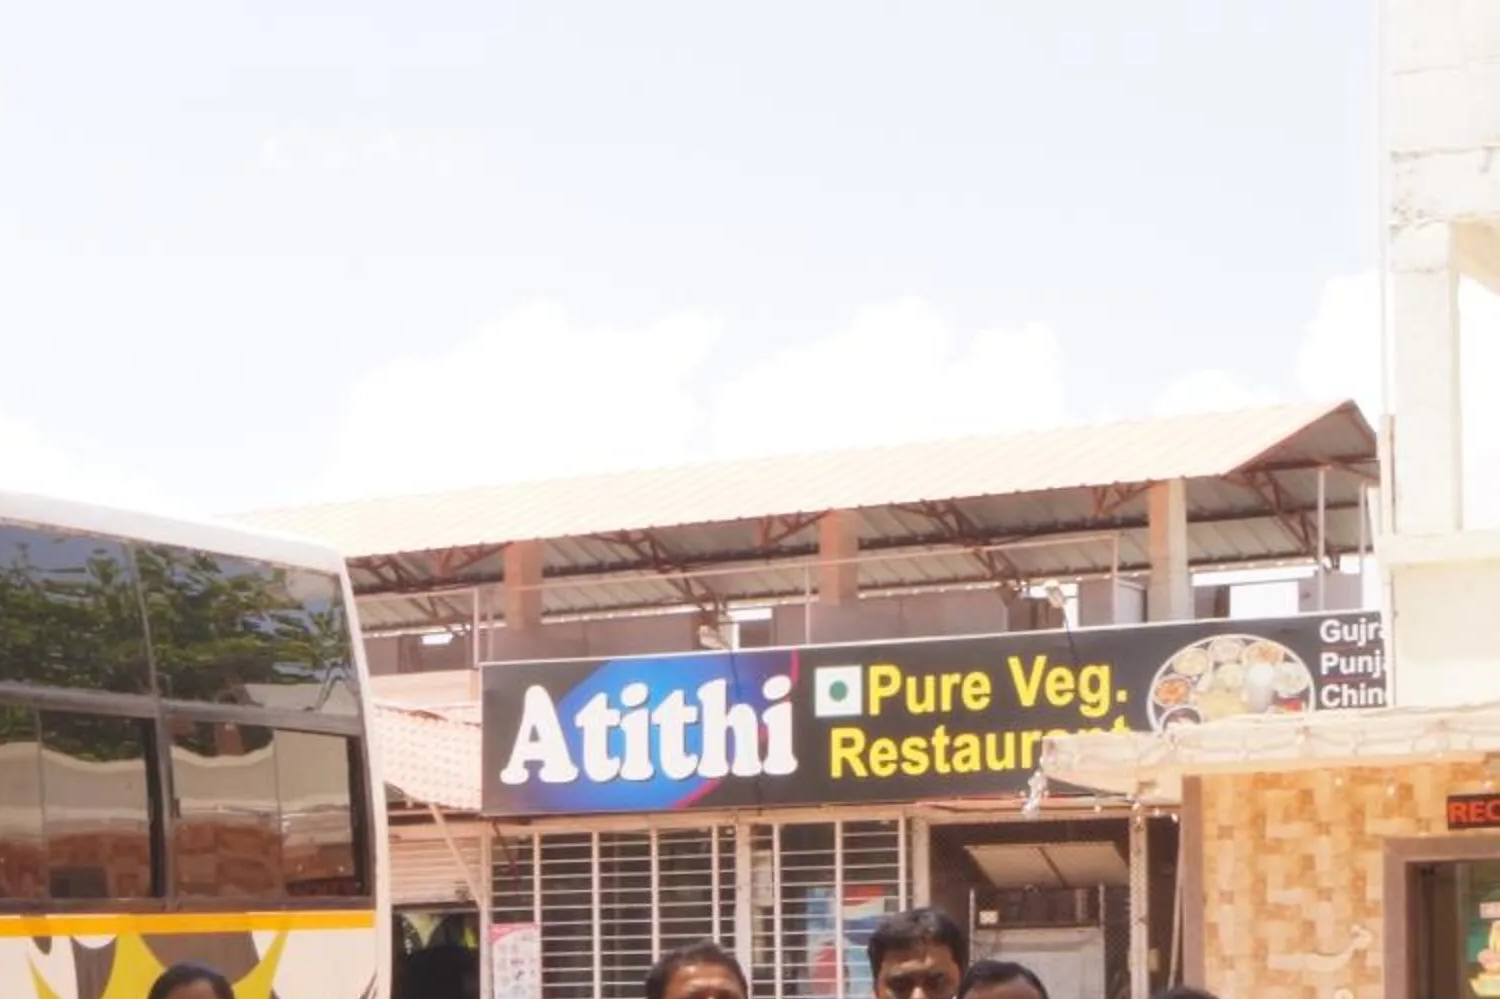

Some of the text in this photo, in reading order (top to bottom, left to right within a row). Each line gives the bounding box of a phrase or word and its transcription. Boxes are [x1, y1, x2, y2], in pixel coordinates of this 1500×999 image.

[1319, 618, 1384, 647] Gujr
[868, 655, 1127, 718] Pure Veg.
[1320, 650, 1386, 678] Punj
[1321, 684, 1386, 707] Chin
[500, 675, 798, 784] Atithi
[830, 715, 1130, 779] Restaur
